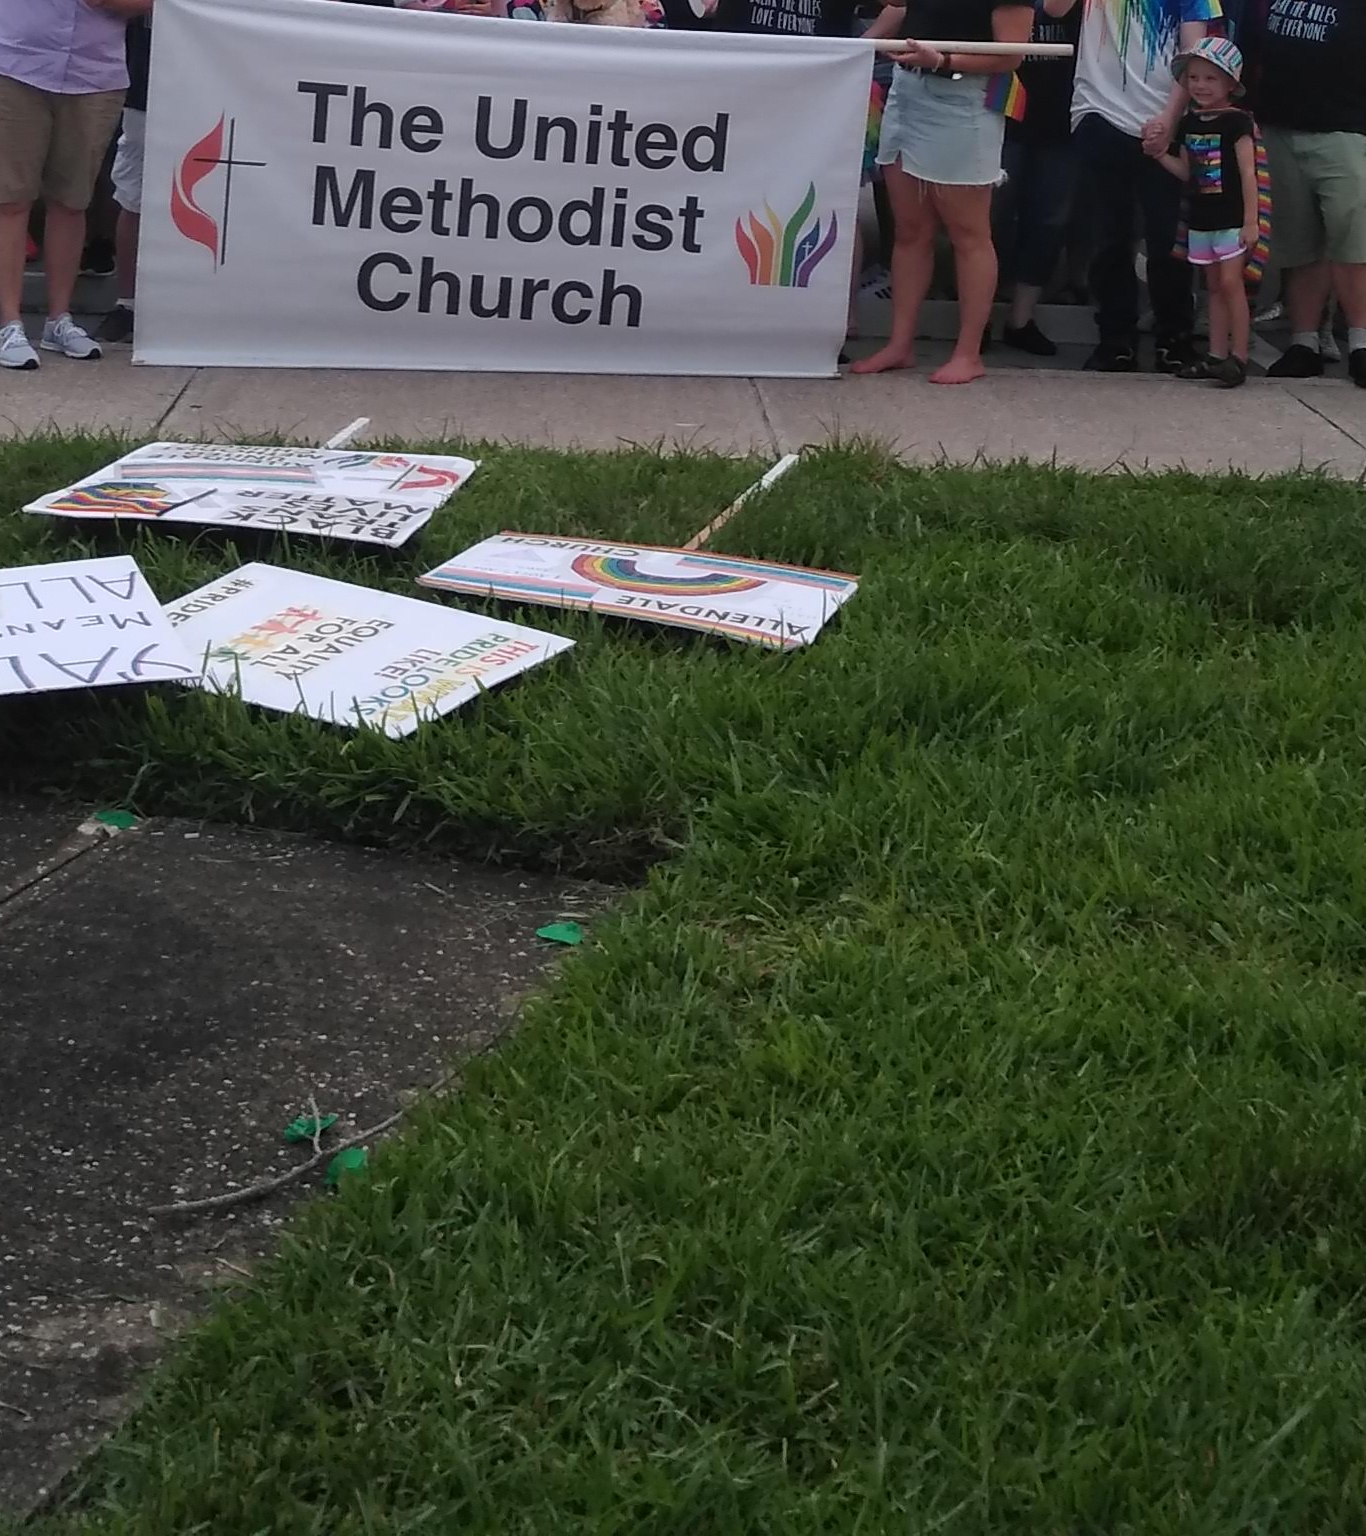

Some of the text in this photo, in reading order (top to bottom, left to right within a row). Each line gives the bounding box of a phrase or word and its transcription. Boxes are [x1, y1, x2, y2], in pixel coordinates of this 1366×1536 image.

[751, 6, 775, 27] LOVE
[296, 79, 730, 173] The United
[311, 164, 704, 254] Methodist
[356, 251, 643, 328] Church
[237, 489, 429, 514] MATTER
[222, 511, 399, 540] BLACK
[501, 536, 640, 557] CHURCH
[615, 594, 812, 635] ALLENDALE
[250, 616, 358, 667] FOR ALL
[275, 618, 395, 681] EQUALITY
[480, 640, 539, 666] THIS
[349, 633, 511, 716] PRIDE LOOKS
[374, 648, 443, 679] LIKE!
